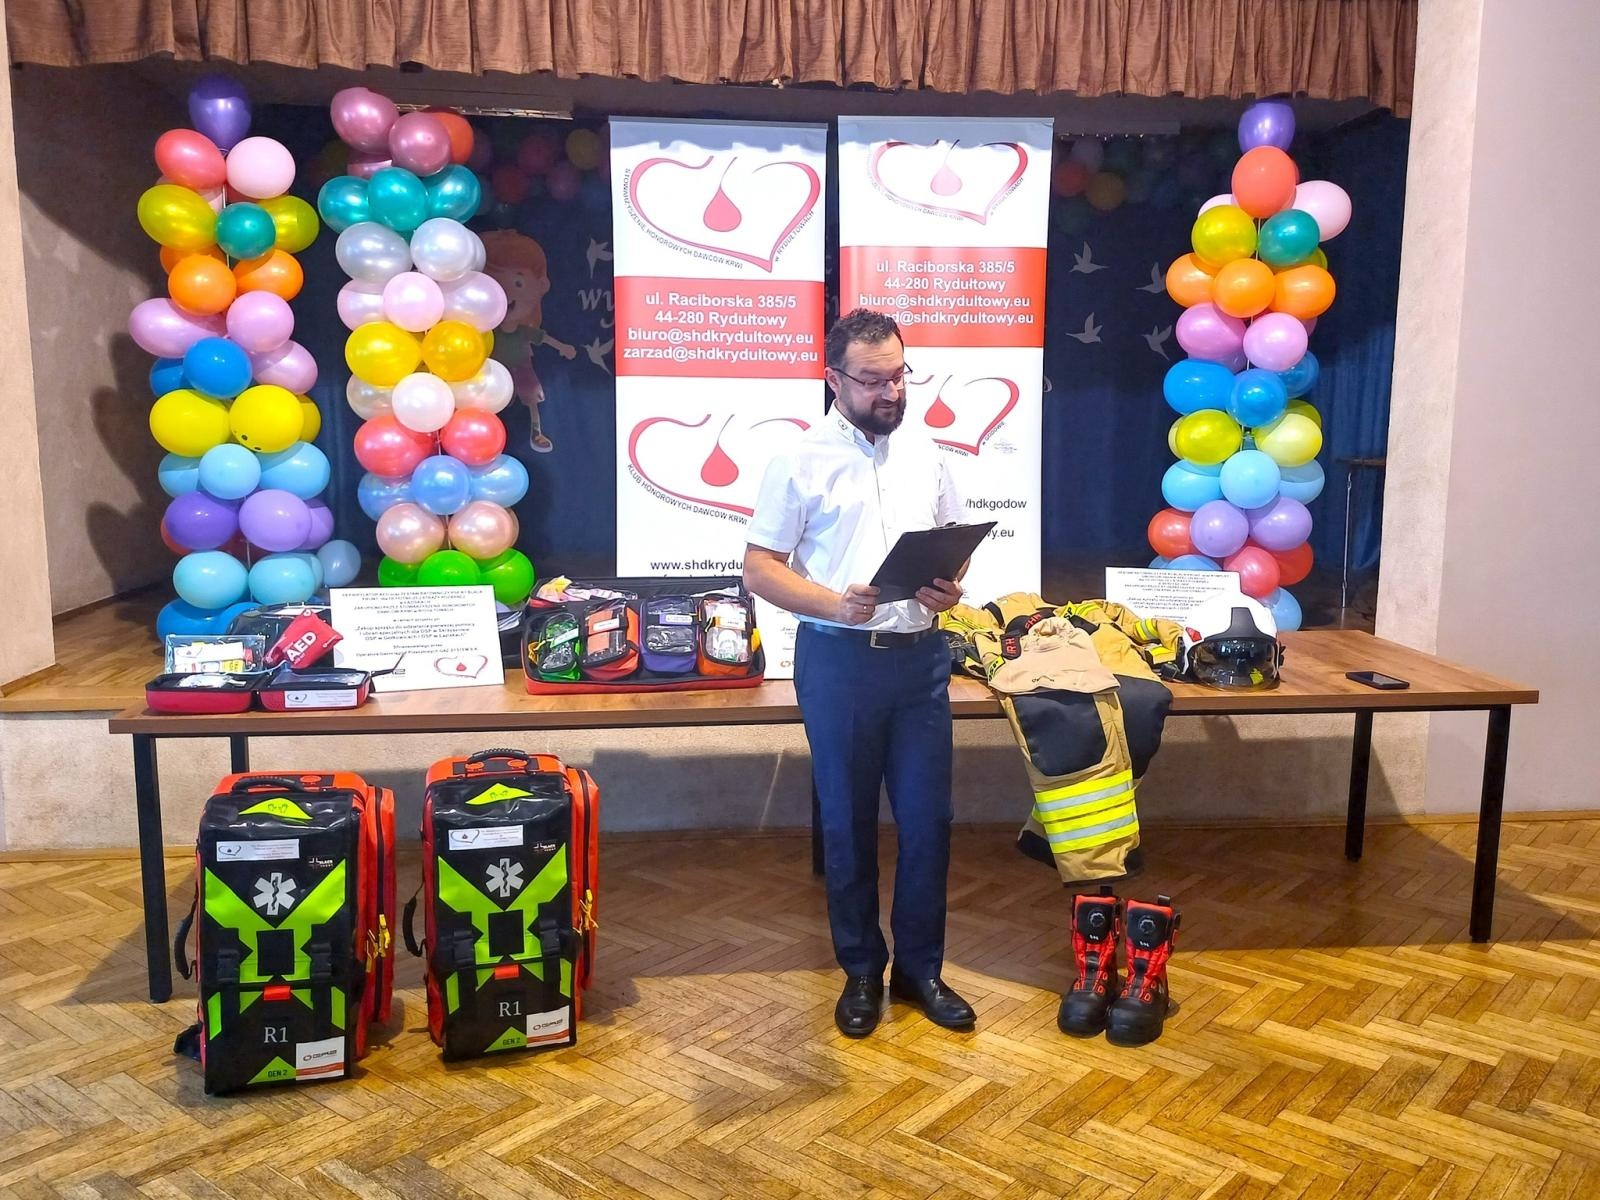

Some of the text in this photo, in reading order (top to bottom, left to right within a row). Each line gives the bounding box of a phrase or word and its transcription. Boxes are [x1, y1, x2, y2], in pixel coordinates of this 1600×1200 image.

[897, 260, 975, 273] Raciborska
[978, 260, 1015, 273] 385/5
[884, 277, 1006, 292] 44-280 Rydułtowy
[645, 292, 797, 309] ul. Raciborska 385/5
[859, 293, 1030, 309] biuro@shdkrydultowy.eu
[655, 310, 787, 329] 44-280 Rydułtowy
[628, 328, 814, 346] biuro@shdkrydultowy.eu
[623, 346, 818, 364] zarzad@shdkrydultowy.eu
[627, 463, 642, 484] KLUB
[641, 480, 692, 511] HONOROWYCH
[728, 513, 748, 526] KRWI
[286, 631, 317, 662] AED
[498, 1001, 522, 1017] R1
[263, 1026, 289, 1043] R1
